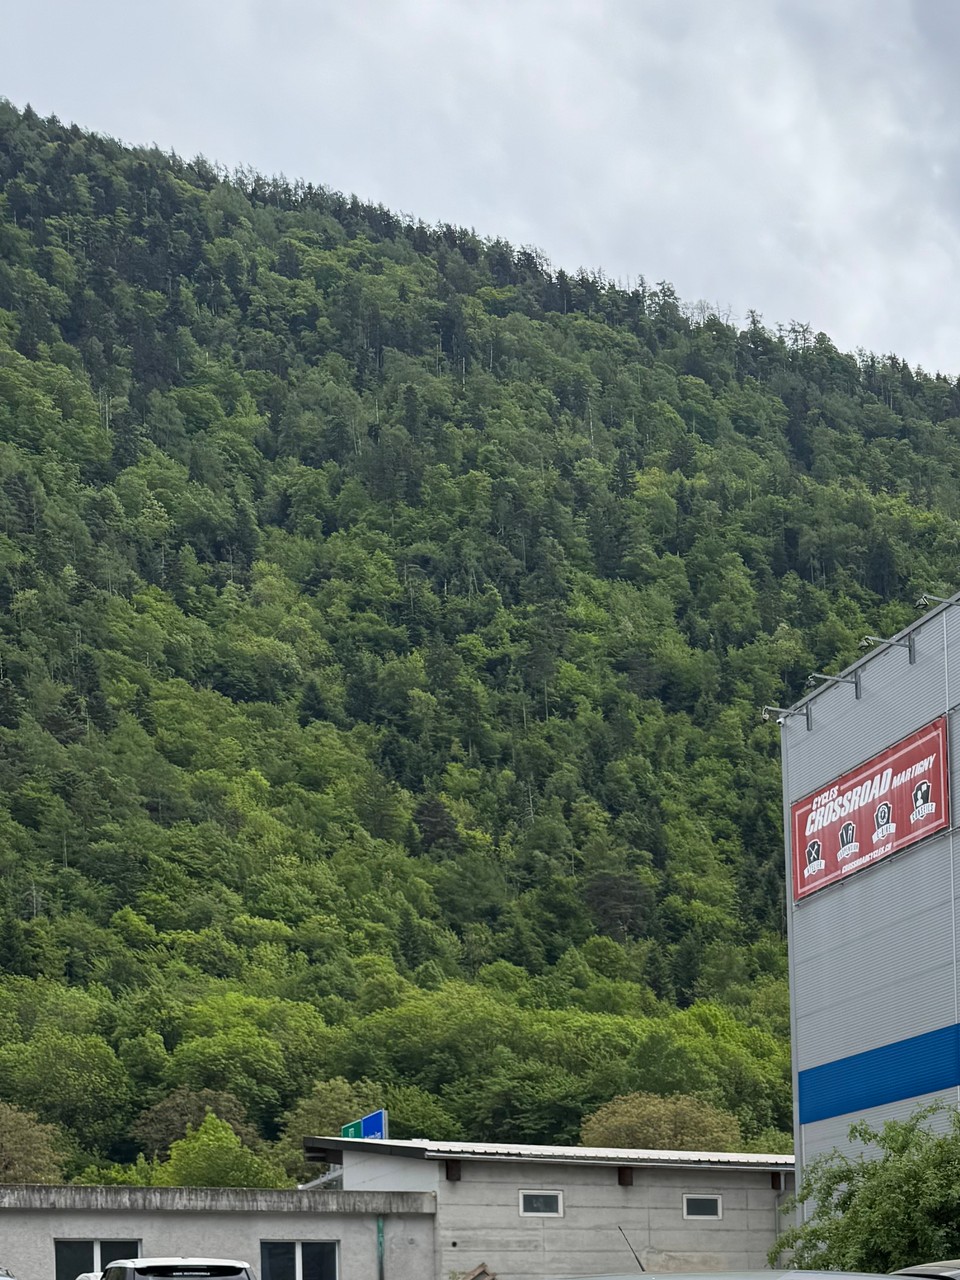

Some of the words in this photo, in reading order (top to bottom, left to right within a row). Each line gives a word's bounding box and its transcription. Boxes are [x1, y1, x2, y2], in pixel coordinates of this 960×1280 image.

[805, 768, 893, 836] CROSSROAD
[891, 753, 936, 789] MARTIGNY
[812, 785, 839, 810] CYCLES
